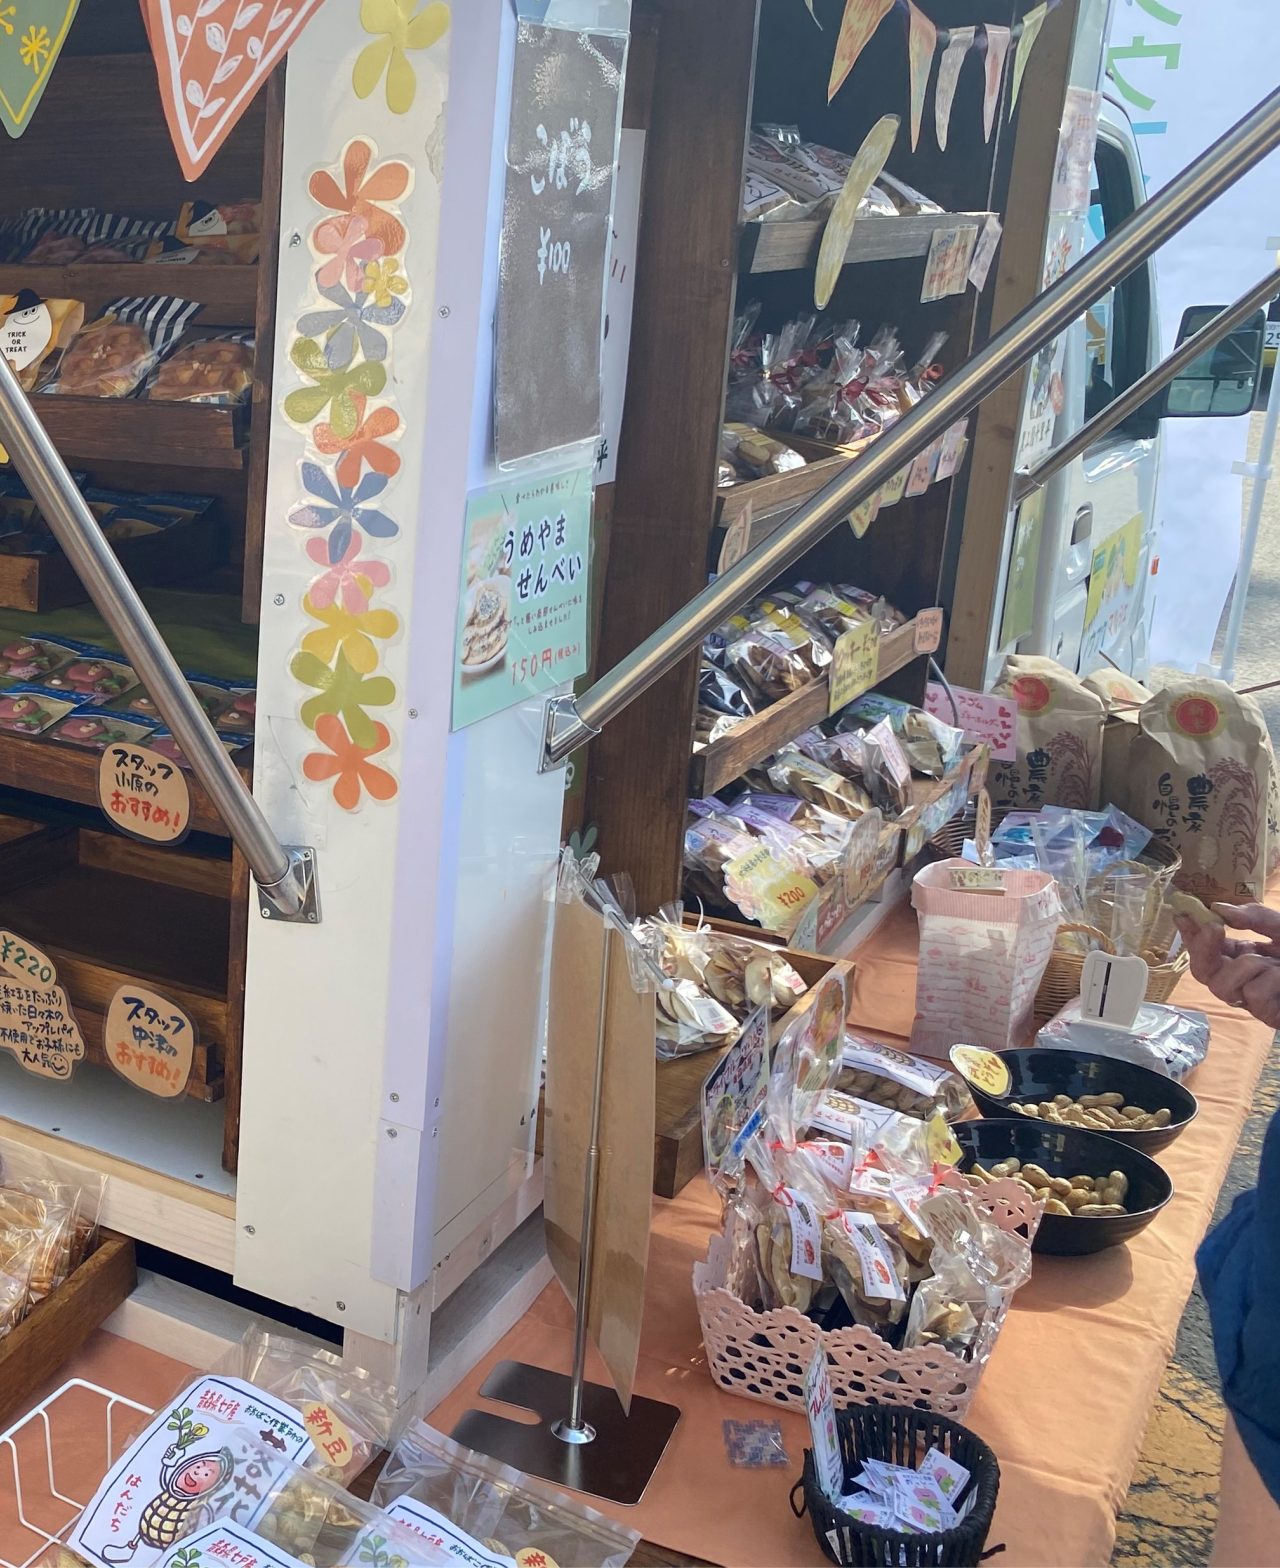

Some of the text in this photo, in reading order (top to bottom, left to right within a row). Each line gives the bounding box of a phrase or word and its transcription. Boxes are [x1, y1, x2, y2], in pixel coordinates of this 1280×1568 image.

[537, 226, 571, 286] ¥100
[504, 513, 566, 564] うめやま
[517, 556, 582, 599] せんべい
[112, 748, 174, 780] スタッフ
[110, 789, 181, 833] おすすめ!
[777, 886, 806, 909] ¥200
[0, 934, 52, 983] ¥220
[21, 1020, 74, 1038] アップルパイ
[122, 996, 186, 1036] スタッフ
[21, 1047, 52, 1069] 大人気
[304, 1406, 348, 1462] 新豆
[110, 1473, 143, 1533] はんだち
